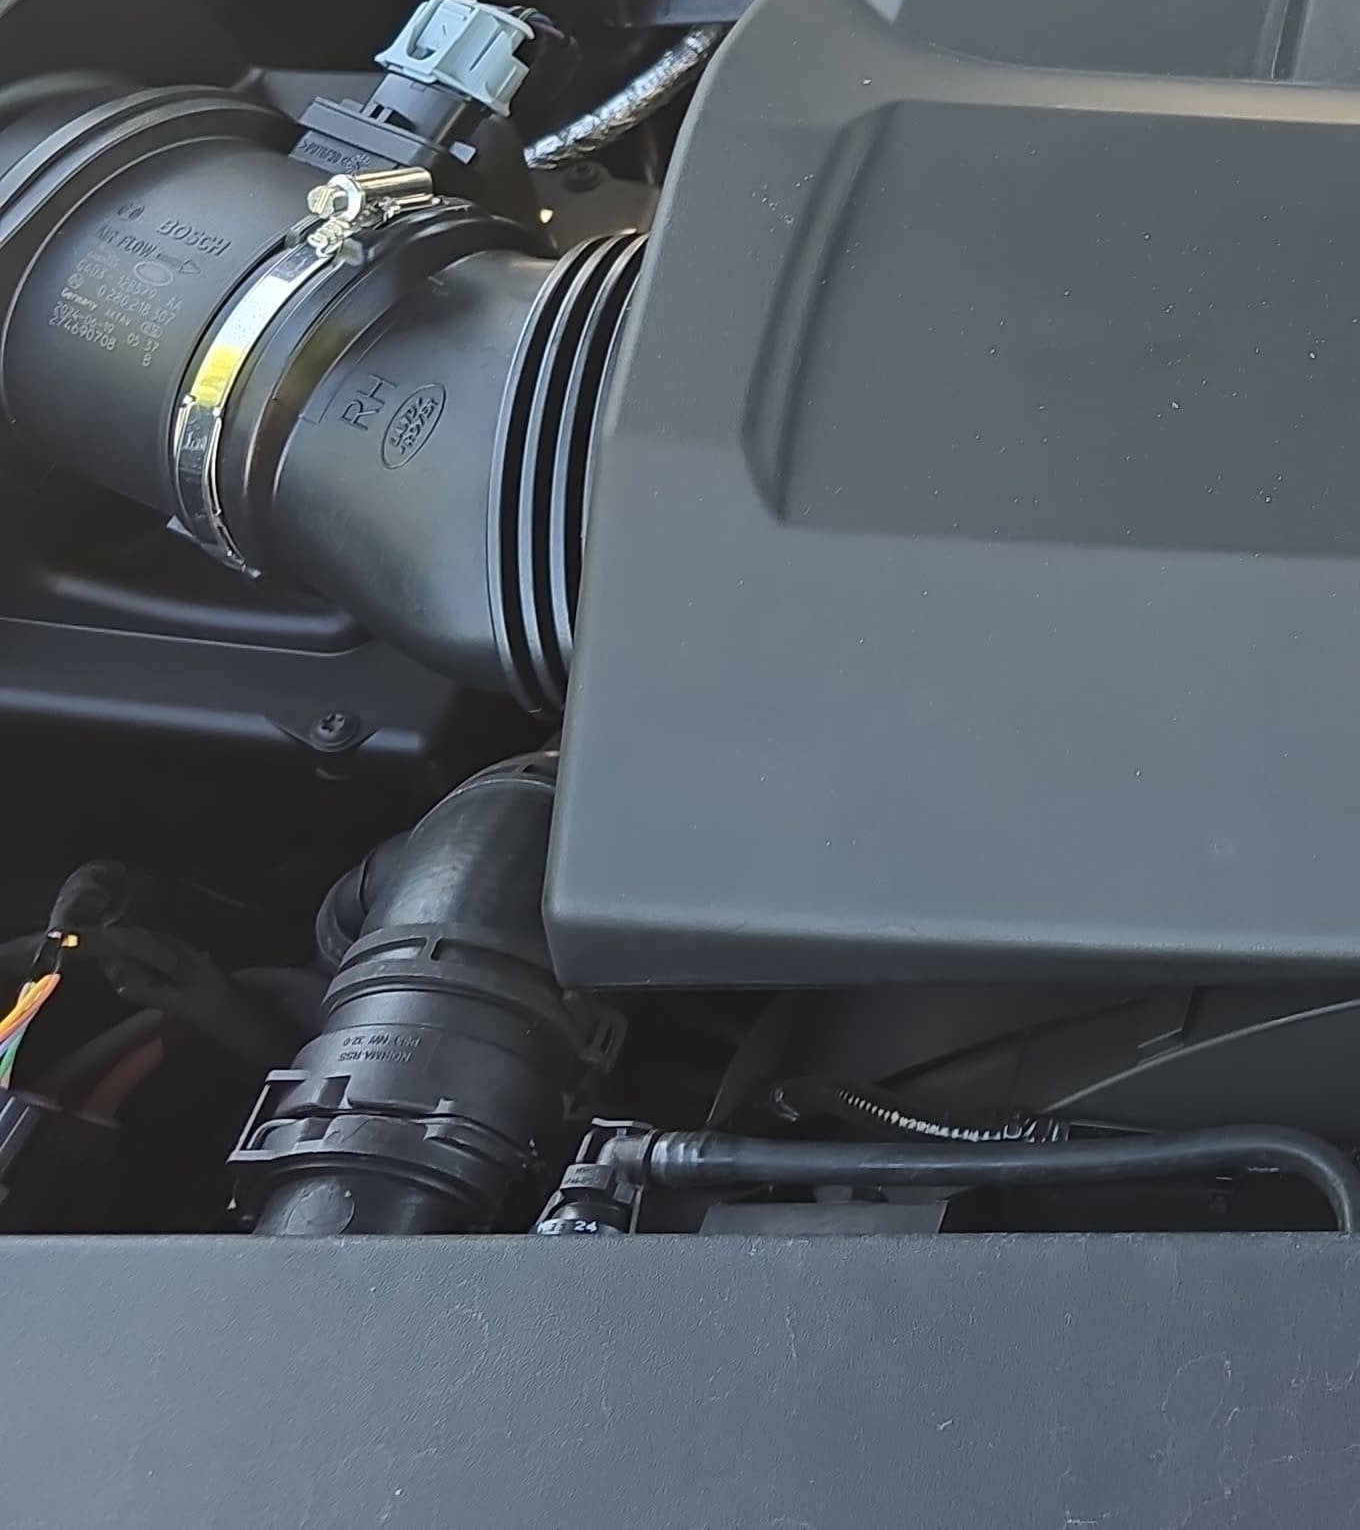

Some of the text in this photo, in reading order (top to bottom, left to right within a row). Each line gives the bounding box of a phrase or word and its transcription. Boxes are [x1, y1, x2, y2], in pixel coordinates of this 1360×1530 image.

[117, 234, 158, 259] FLOW
[157, 219, 232, 257] BOSCH
[341, 374, 397, 431] RH
